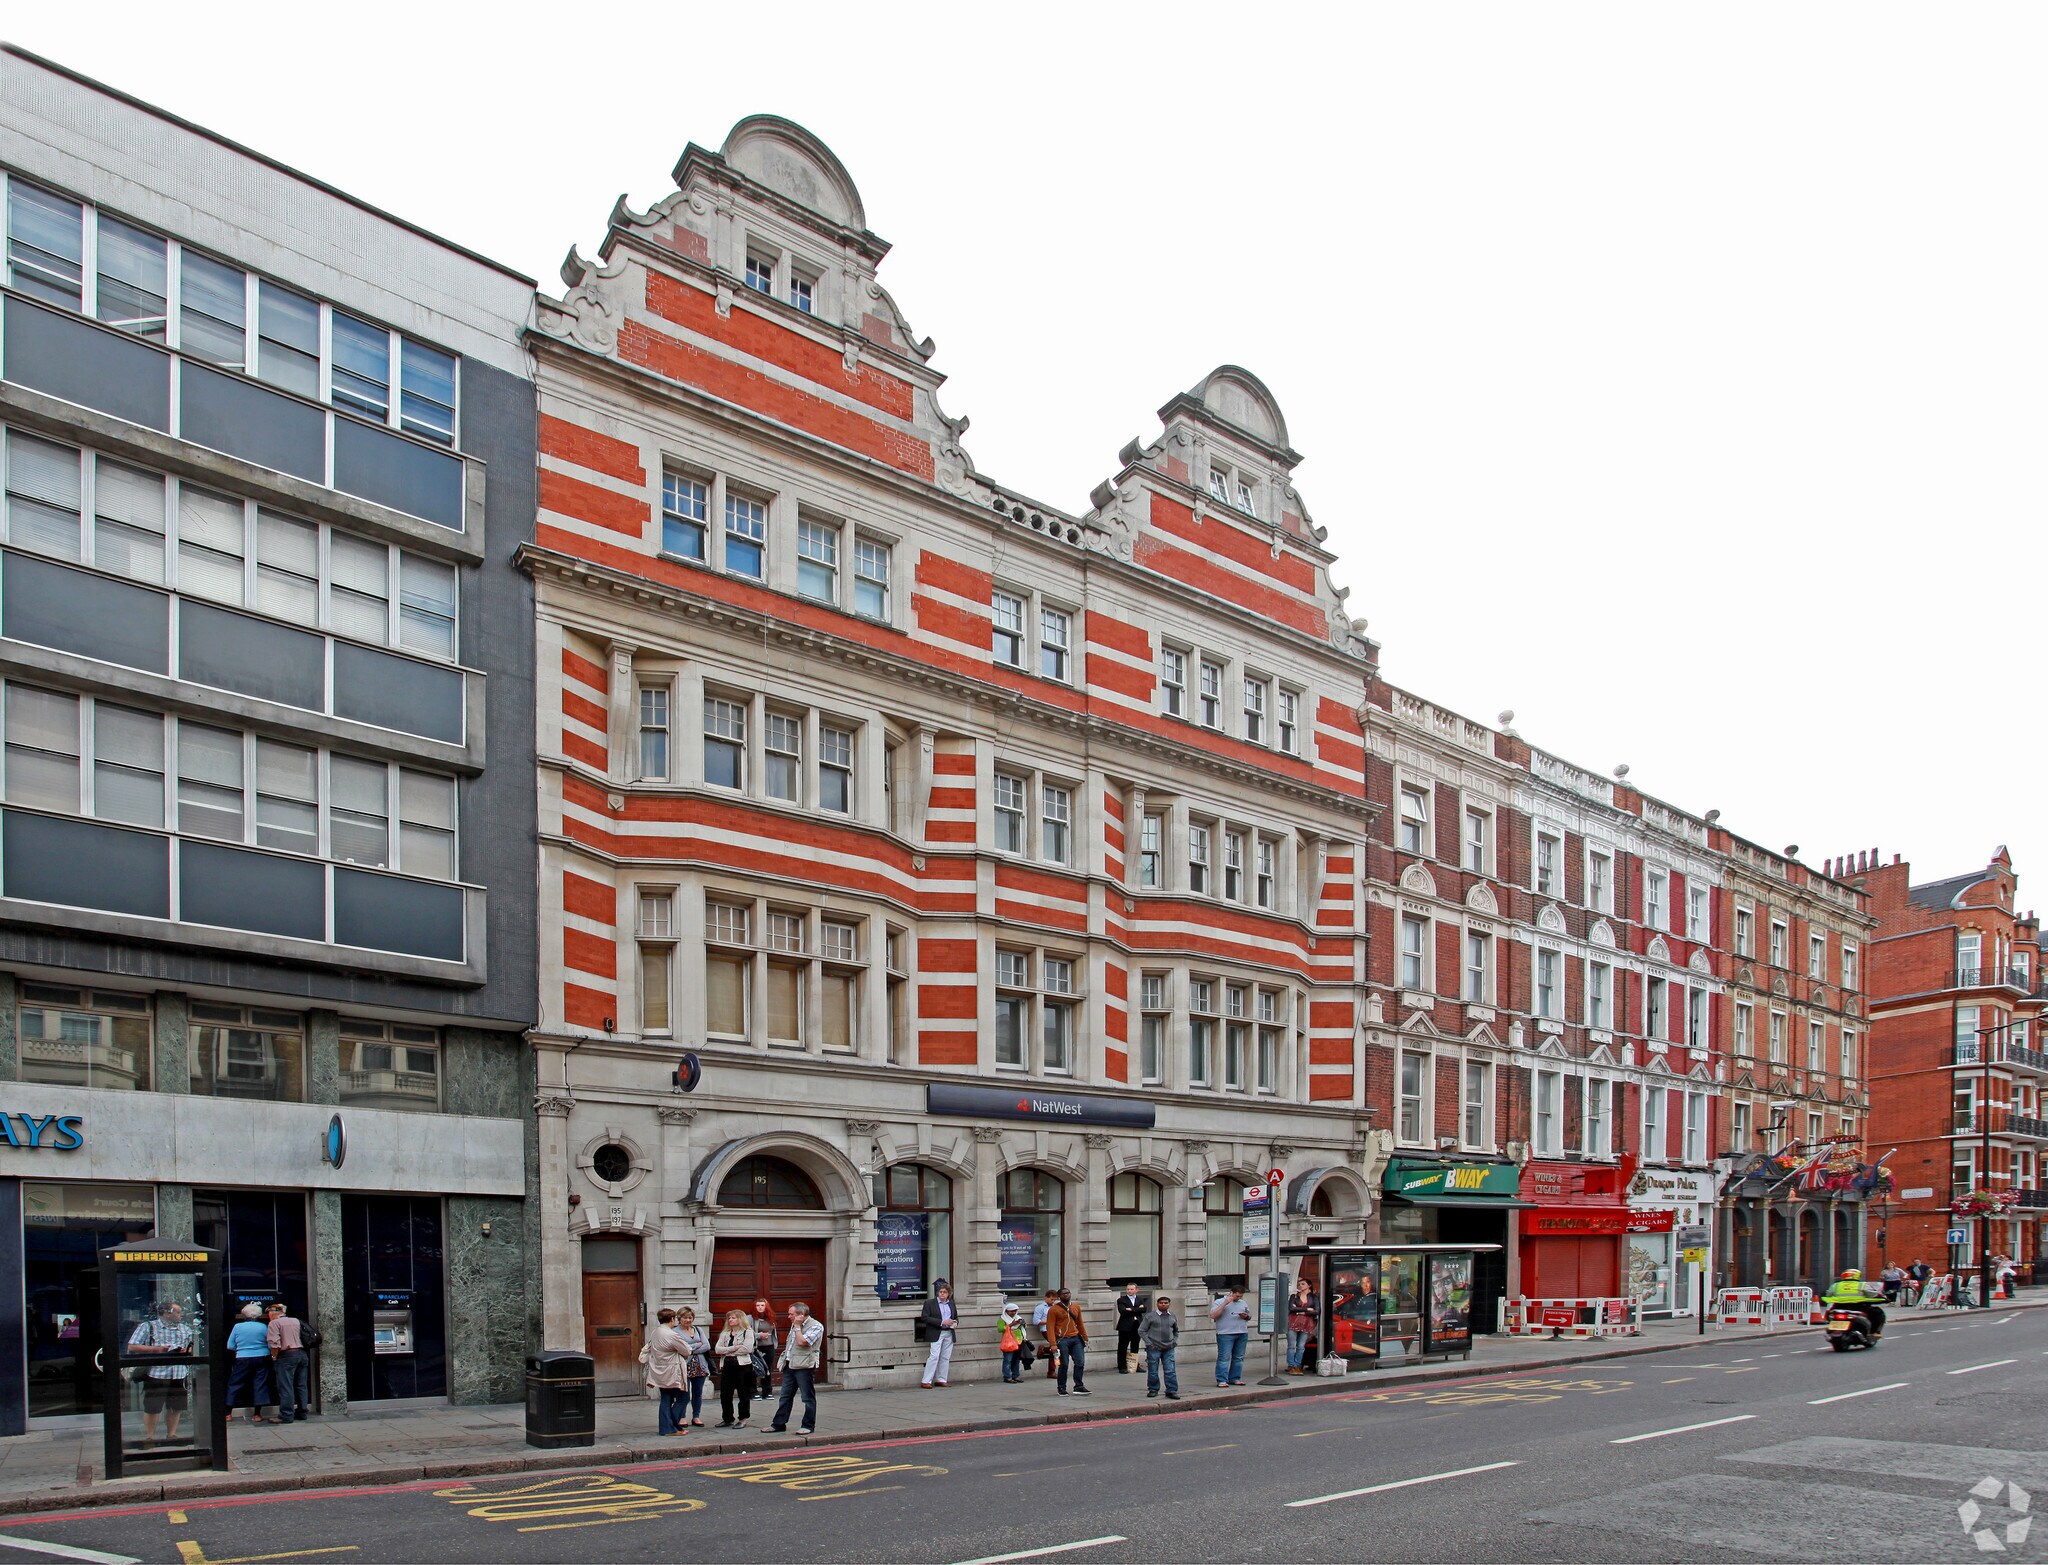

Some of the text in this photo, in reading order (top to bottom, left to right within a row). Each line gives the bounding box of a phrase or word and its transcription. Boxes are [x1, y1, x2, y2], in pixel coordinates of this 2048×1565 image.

[1032, 1100, 1082, 1115] NatWest
[0, 1112, 84, 1150] AYS
[754, 1176, 767, 1184] 195
[1270, 1171, 1280, 1182] A
[1403, 1174, 1443, 1190] SUBWAY
[1444, 1168, 1490, 1188] BWAY
[878, 1256, 914, 1264] pplications
[696, 1456, 949, 1490] BUS
